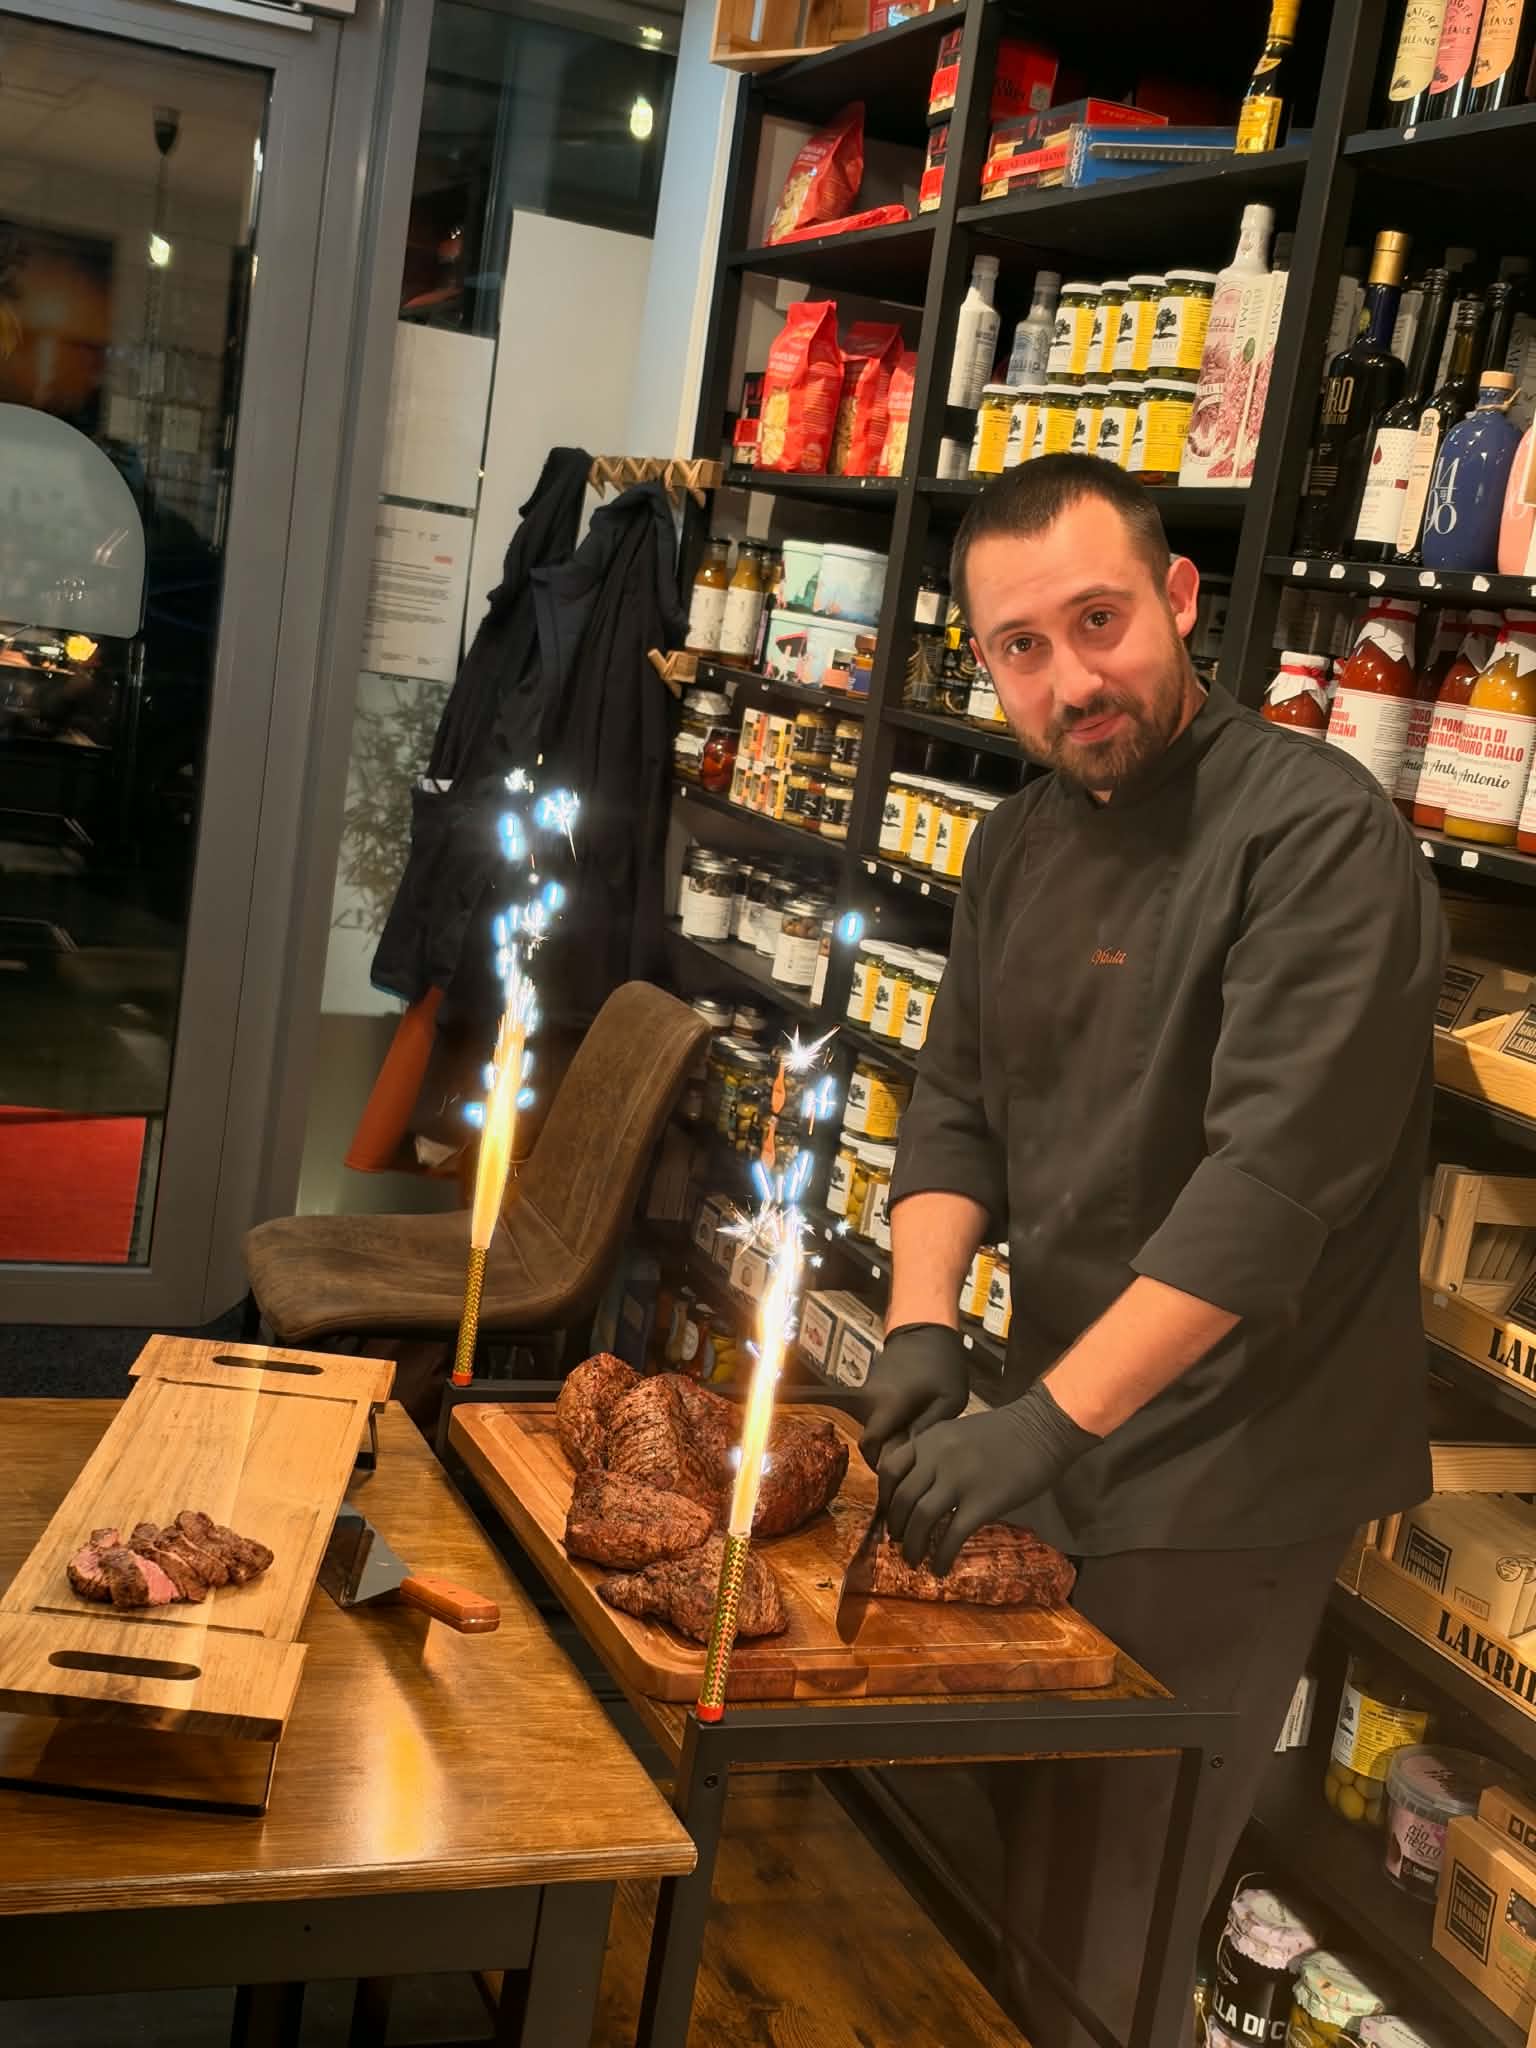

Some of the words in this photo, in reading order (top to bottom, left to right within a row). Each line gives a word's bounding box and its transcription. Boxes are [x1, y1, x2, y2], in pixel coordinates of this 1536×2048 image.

[1493, 728, 1508, 744] DI
[1484, 742, 1525, 763] GIALLO
[1242, 2012, 1265, 2038] DI
